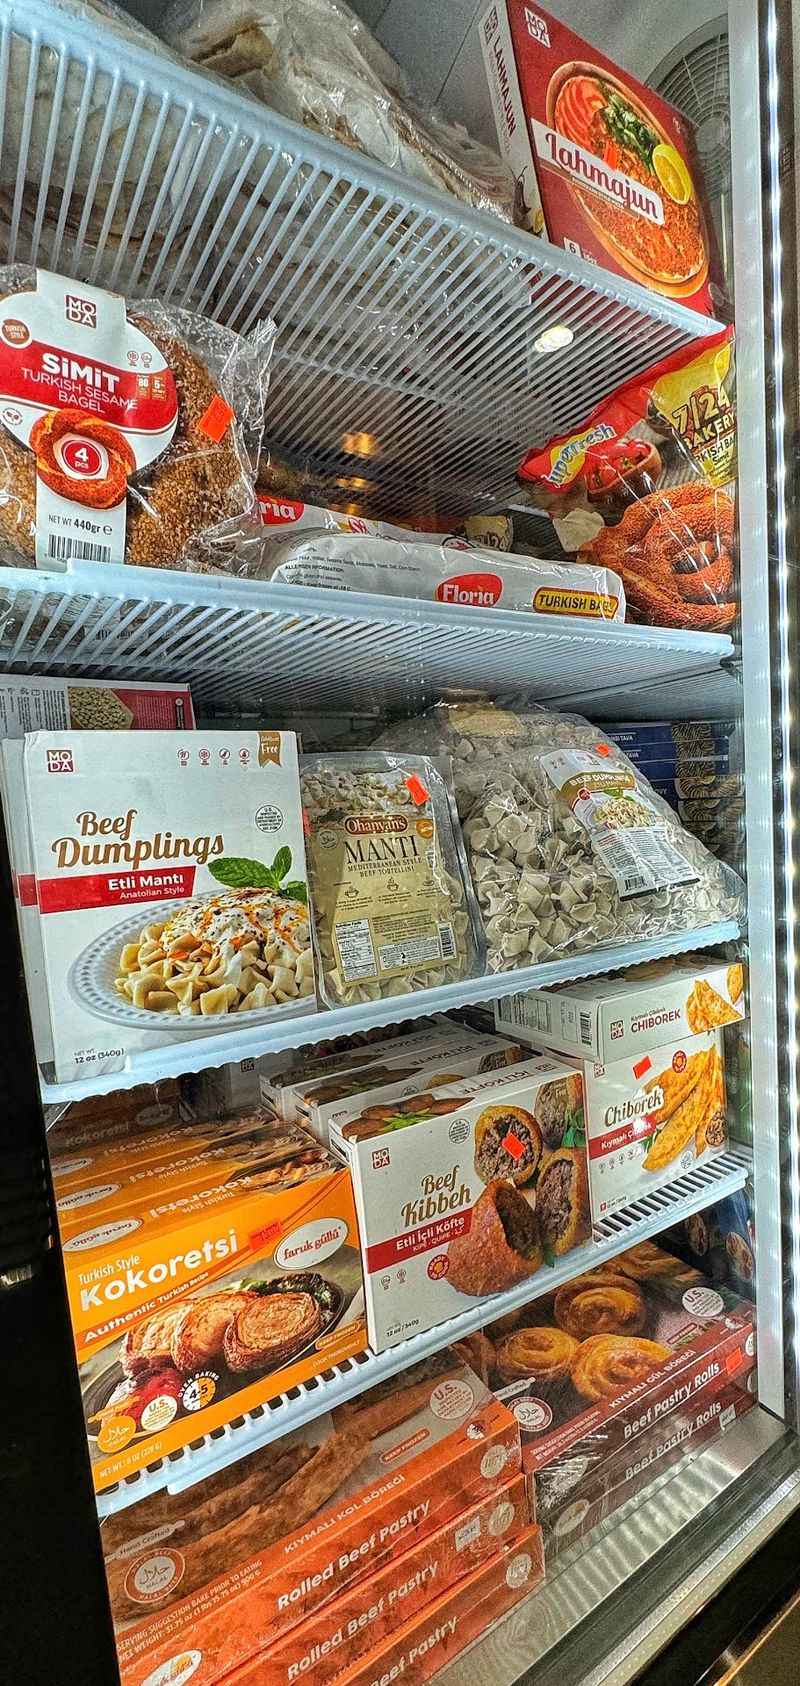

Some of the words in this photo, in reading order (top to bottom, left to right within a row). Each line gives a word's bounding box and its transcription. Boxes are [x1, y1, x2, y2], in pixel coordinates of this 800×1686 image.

[494, 36, 517, 138] LAHMAJUN
[545, 131, 659, 220] Lahmajun
[569, 243, 576, 255] 6
[68, 297, 96, 316] MO
[68, 309, 96, 328] DA
[21, 367, 82, 394] TURKISH
[85, 385, 138, 411] SESAME
[58, 391, 105, 414] BAGEL
[74, 447, 89, 462] 4
[74, 461, 90, 469] pcs
[49, 514, 61, 525] NET
[62, 517, 72, 528] WT
[73, 519, 101, 534] 440gr
[442, 584, 495, 605] Floria
[539, 594, 588, 610] TURKISH
[47, 751, 72, 763] MO
[261, 742, 279, 755] Free
[48, 761, 73, 772] DA
[76, 809, 138, 841] Beef
[345, 816, 407, 834] Ohanyan's
[51, 832, 225, 870] Dumplings
[344, 834, 420, 864] MANTI
[347, 859, 401, 872] MEDITERRANEAN
[402, 857, 422, 865] STYLE
[360, 869, 376, 878] BEEF
[378, 865, 415, 876] TORTELLINI
[108, 877, 136, 892] Etli
[120, 888, 163, 900] Anatolian
[164, 885, 185, 897] Style
[631, 1008, 681, 1033] CHIBOREK
[75, 1056, 84, 1064] 12
[98, 1047, 125, 1061] (340g)
[604, 1088, 664, 1128] Chiborek
[128, 1147, 225, 1183] Kokoretsi
[374, 1149, 389, 1160] MO
[374, 1158, 390, 1169] DA
[421, 1165, 460, 1196] Beef
[149, 1176, 253, 1218] Kokoretsi
[181, 1200, 204, 1214] Style
[204, 1191, 235, 1208] Turkish
[401, 1184, 472, 1227] Kibbeh
[283, 1240, 314, 1262] faruk
[314, 1228, 341, 1251] güllü
[396, 1233, 416, 1251] Etli
[417, 1227, 434, 1245] İçli
[436, 1216, 465, 1235] Köfte
[78, 1263, 115, 1286] Turkish
[115, 1254, 141, 1275] Style
[80, 1229, 240, 1313] Kokoretsi
[686, 1289, 705, 1304] U.S.
[84, 1300, 157, 1343] Authentic
[157, 1282, 189, 1306] Turkish
[177, 1377, 195, 1398] OVEN
[194, 1367, 221, 1382] BAKING
[189, 1384, 209, 1401] 4-5
[433, 1383, 459, 1401] U.S.
[149, 1397, 168, 1412] U.S.
[608, 1382, 647, 1409] KIYMALI
[624, 1409, 652, 1439] Beef
[653, 1383, 693, 1416] Pastry
[693, 1362, 720, 1389] Rolls
[625, 1453, 654, 1481] Beef
[655, 1426, 696, 1459] Pastry
[696, 1401, 722, 1427] Rolls
[284, 1518, 337, 1554] KIYMALI
[337, 1502, 362, 1521] KOL
[277, 1567, 337, 1610] Rolled
[338, 1538, 376, 1571] Beef
[379, 1499, 431, 1542] Pastry
[116, 1625, 149, 1652] SERVING
[147, 1604, 191, 1634] SUGGESTION
[207, 1580, 231, 1598] PRIOR
[229, 1572, 240, 1584] TO
[238, 1559, 264, 1579] EATING
[287, 1631, 344, 1680] Rolled
[347, 1601, 385, 1636] Beef
[388, 1561, 439, 1605] Pastry
[370, 1657, 406, 1686] Beef
[408, 1616, 459, 1665] Pastry
